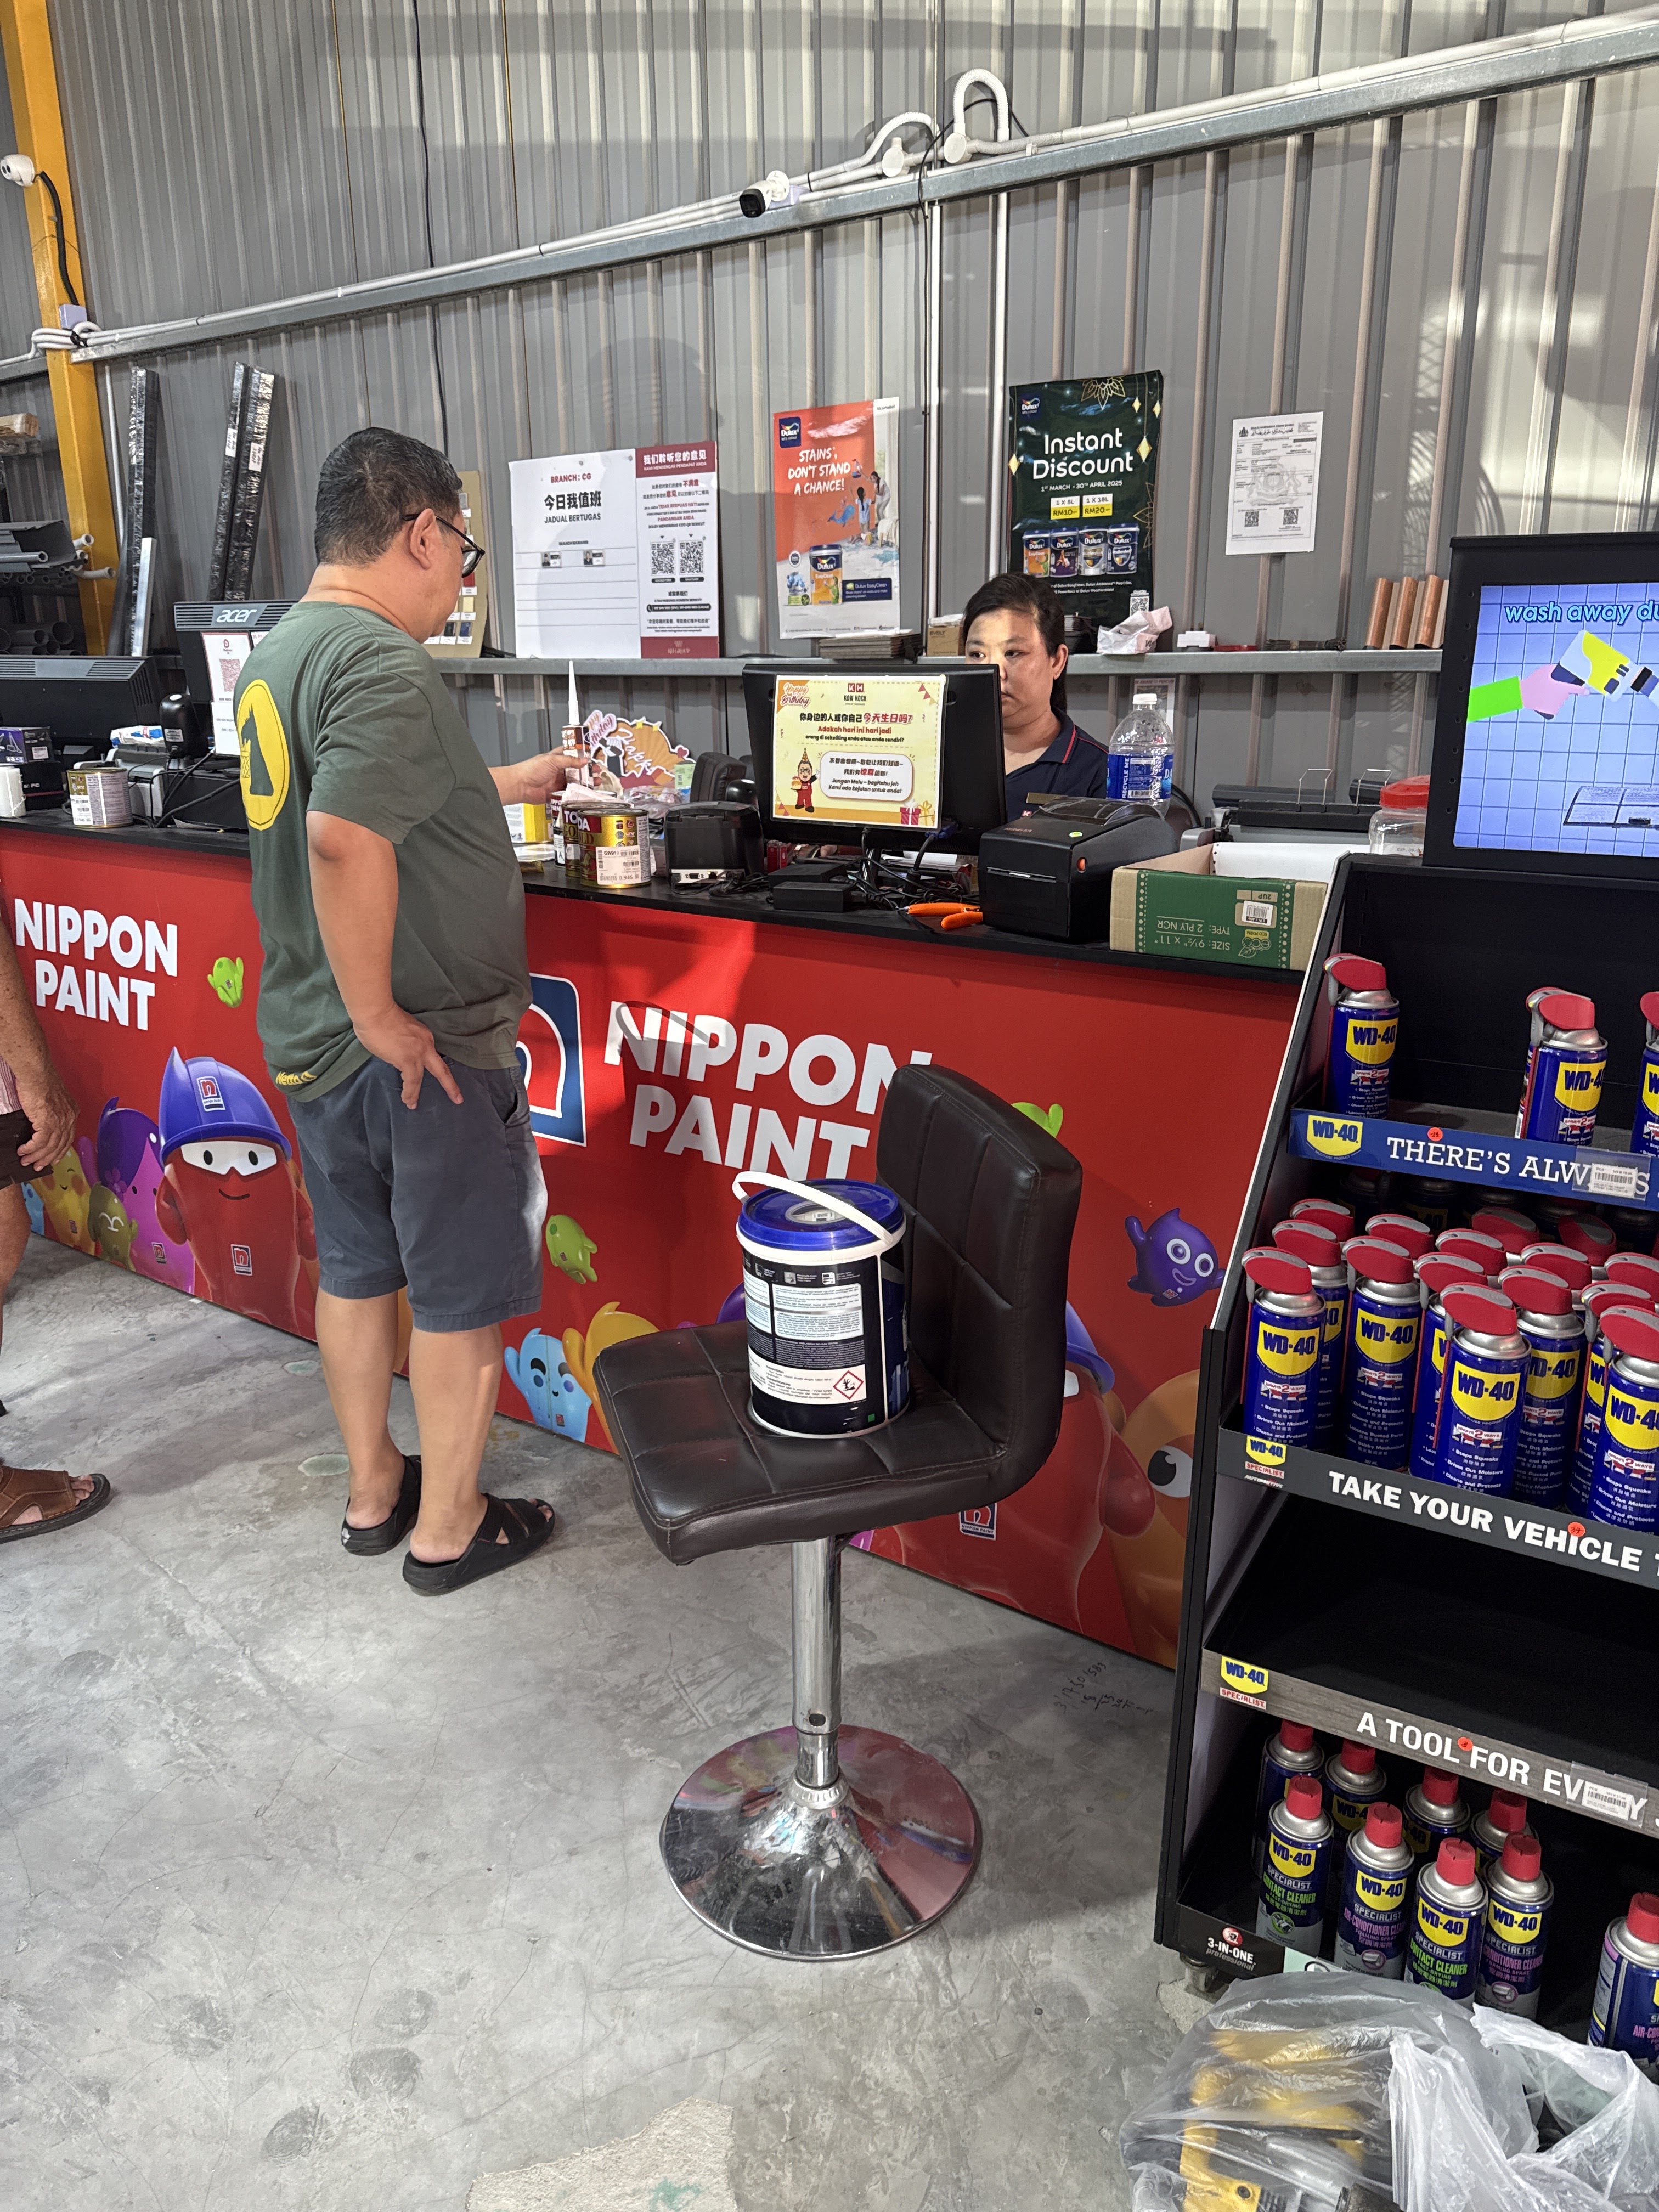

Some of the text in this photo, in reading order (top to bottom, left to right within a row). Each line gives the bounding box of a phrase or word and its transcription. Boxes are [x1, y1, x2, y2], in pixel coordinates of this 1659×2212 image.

[1045, 428, 1122, 454] Instant
[644, 450, 707, 465] 我们聆听您的意见
[1033, 452, 1133, 479] Discount
[788, 462, 850, 479] DON'T STAND
[794, 478, 844, 496] A CHANCE!
[544, 491, 601, 511] 今日我值班
[544, 513, 601, 523] JADUAL BERTUGAS
[217, 609, 257, 623] acer
[1505, 601, 1562, 623] wash
[1566, 602, 1633, 625] away
[783, 684, 808, 696] Happy
[781, 695, 810, 708] Birthday
[800, 713, 862, 723] 你身边的人或你自己
[1124, 757, 1130, 768] ME
[564, 811, 578, 824] TO
[1157, 920, 1177, 930] NCR
[1197, 924, 1203, 933] 2
[1209, 925, 1230, 935] TYPE:
[14, 899, 178, 977] NIPPON
[1209, 940, 1230, 951] SIZE:
[35, 960, 155, 1031] PAINT
[1353, 1025, 1396, 1045] WD-40
[605, 1001, 933, 1115] NIPPON
[1565, 1069, 1605, 1091] WD-4
[630, 1084, 870, 1181] PAINT
[1312, 1120, 1650, 1194] WD-40 THERE'S ALWS
[1361, 1317, 1413, 1344] WD-40
[1263, 1330, 1316, 1356] WD-40
[1378, 1372, 1385, 1380] 2
[1458, 1370, 1515, 1401] WD-40
[1282, 1384, 1289, 1393] 2
[1538, 1408, 1547, 1417] 2
[1475, 1429, 1483, 1439] 2
[1250, 1439, 1283, 1459] WD-40
[1247, 1463, 1283, 1477] SPECIALIST
[1447, 1459, 1464, 1471] Drives
[1626, 1457, 1634, 1468] 2
[1329, 1470, 1643, 1572] TAKE YOUR VEHICLE
[1225, 1660, 1265, 1685] WD-40
[1222, 1689, 1265, 1707] SPECIALIST
[1356, 1711, 1648, 1822] A TOOL FOR EVY
[1273, 1838, 1312, 1866] WD-40
[1267, 1865, 1312, 1889] SPECIALIST
[1361, 1875, 1403, 1898] WD-40
[1263, 1871, 1316, 1904] CONTACT CLEANER
[1354, 1903, 1401, 1921] SPECIALIST
[1421, 1903, 1464, 1936] WD-40
[1493, 1903, 1538, 1931] WD-40
[1415, 1931, 1463, 1961] SPECIALIST
[1486, 1933, 1536, 1955] SPECIALIST
[1205, 1947, 1255, 1971] professional
[1410, 1937, 1435, 1968] CONTACT
[1436, 1960, 1468, 1975] CLEANER
